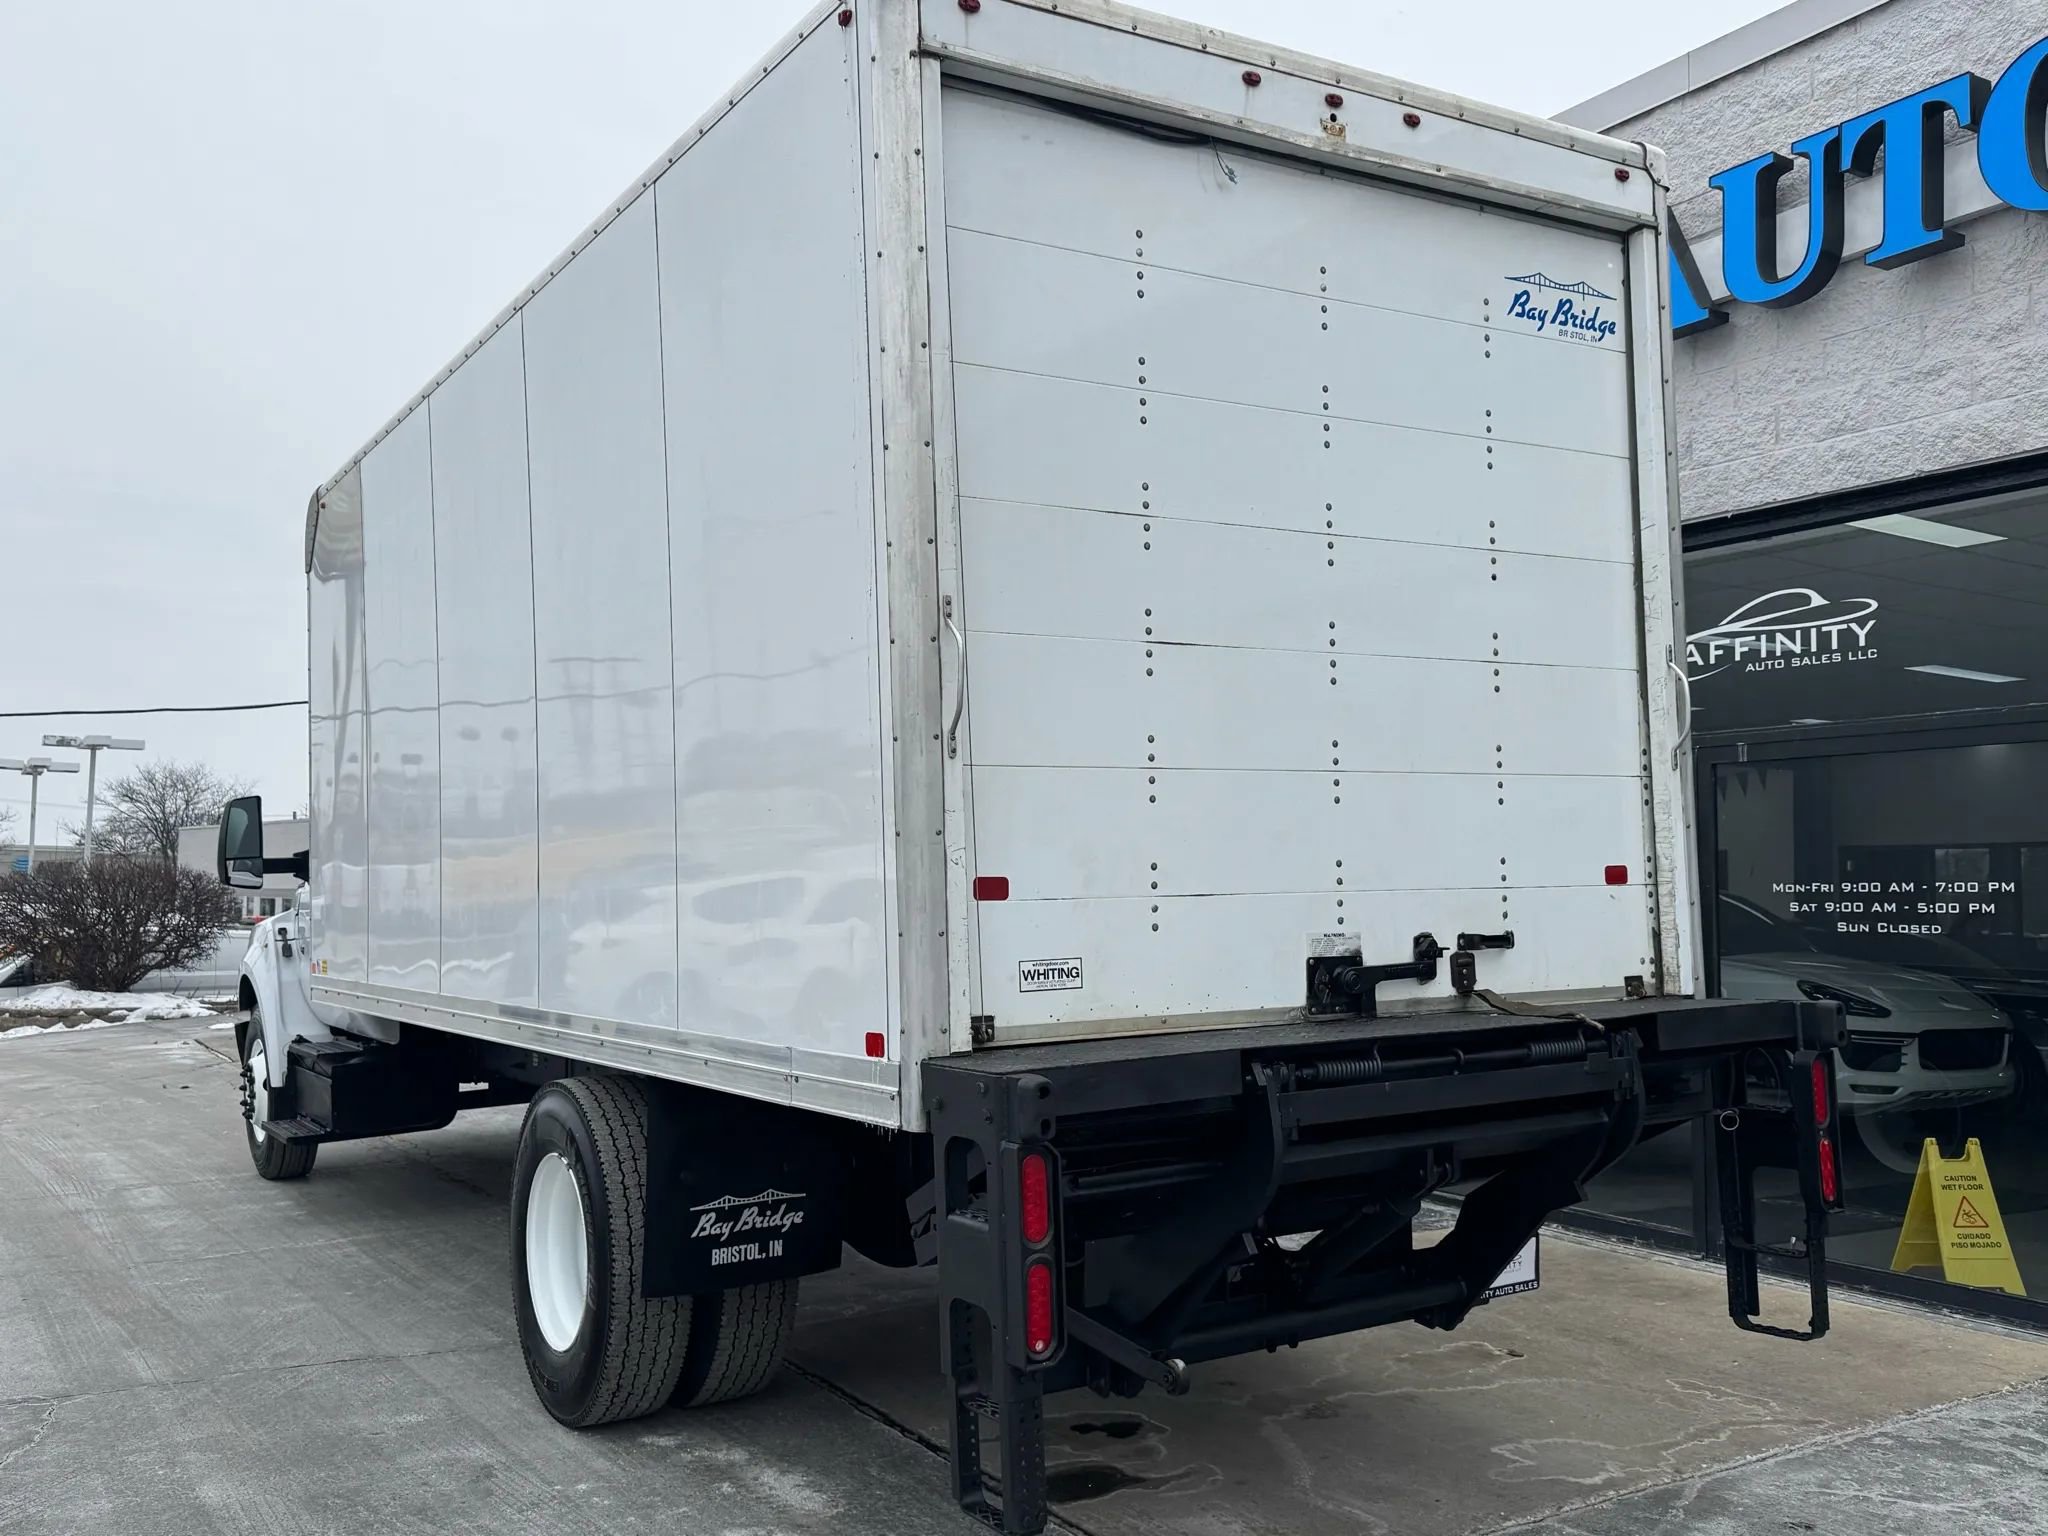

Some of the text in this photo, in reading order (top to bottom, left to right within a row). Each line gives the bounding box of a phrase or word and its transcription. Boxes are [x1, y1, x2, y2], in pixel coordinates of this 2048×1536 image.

[1507, 290, 1616, 342] Bay Bridge
[1558, 329, 1589, 342] BRSTOL,
[1687, 620, 1876, 666] AFFINITY
[1745, 649, 1877, 672] AUTO SALES LLC
[1841, 882, 1881, 892] 9:00
[1889, 882, 1914, 892] AM
[1936, 882, 1979, 893] 7:00
[1988, 882, 2015, 893] PM
[1789, 902, 1818, 912] SAT
[1825, 902, 1864, 912] 9:00
[1871, 902, 1897, 912] AM
[1917, 903, 1960, 913] 5:00
[1968, 903, 1995, 914] PM
[1837, 922, 1942, 934] SUN CLOSED
[1022, 966, 1080, 981] WHITING
[1958, 1183, 1984, 1191] FLOOR
[690, 1203, 804, 1242] Bay Bridge
[1970, 1241, 2002, 1249] MOJADO
[712, 1240, 783, 1266] BRISTOL, IN
[1495, 1286, 1513, 1296] AUTO
[1515, 1281, 1538, 1292] SALES
